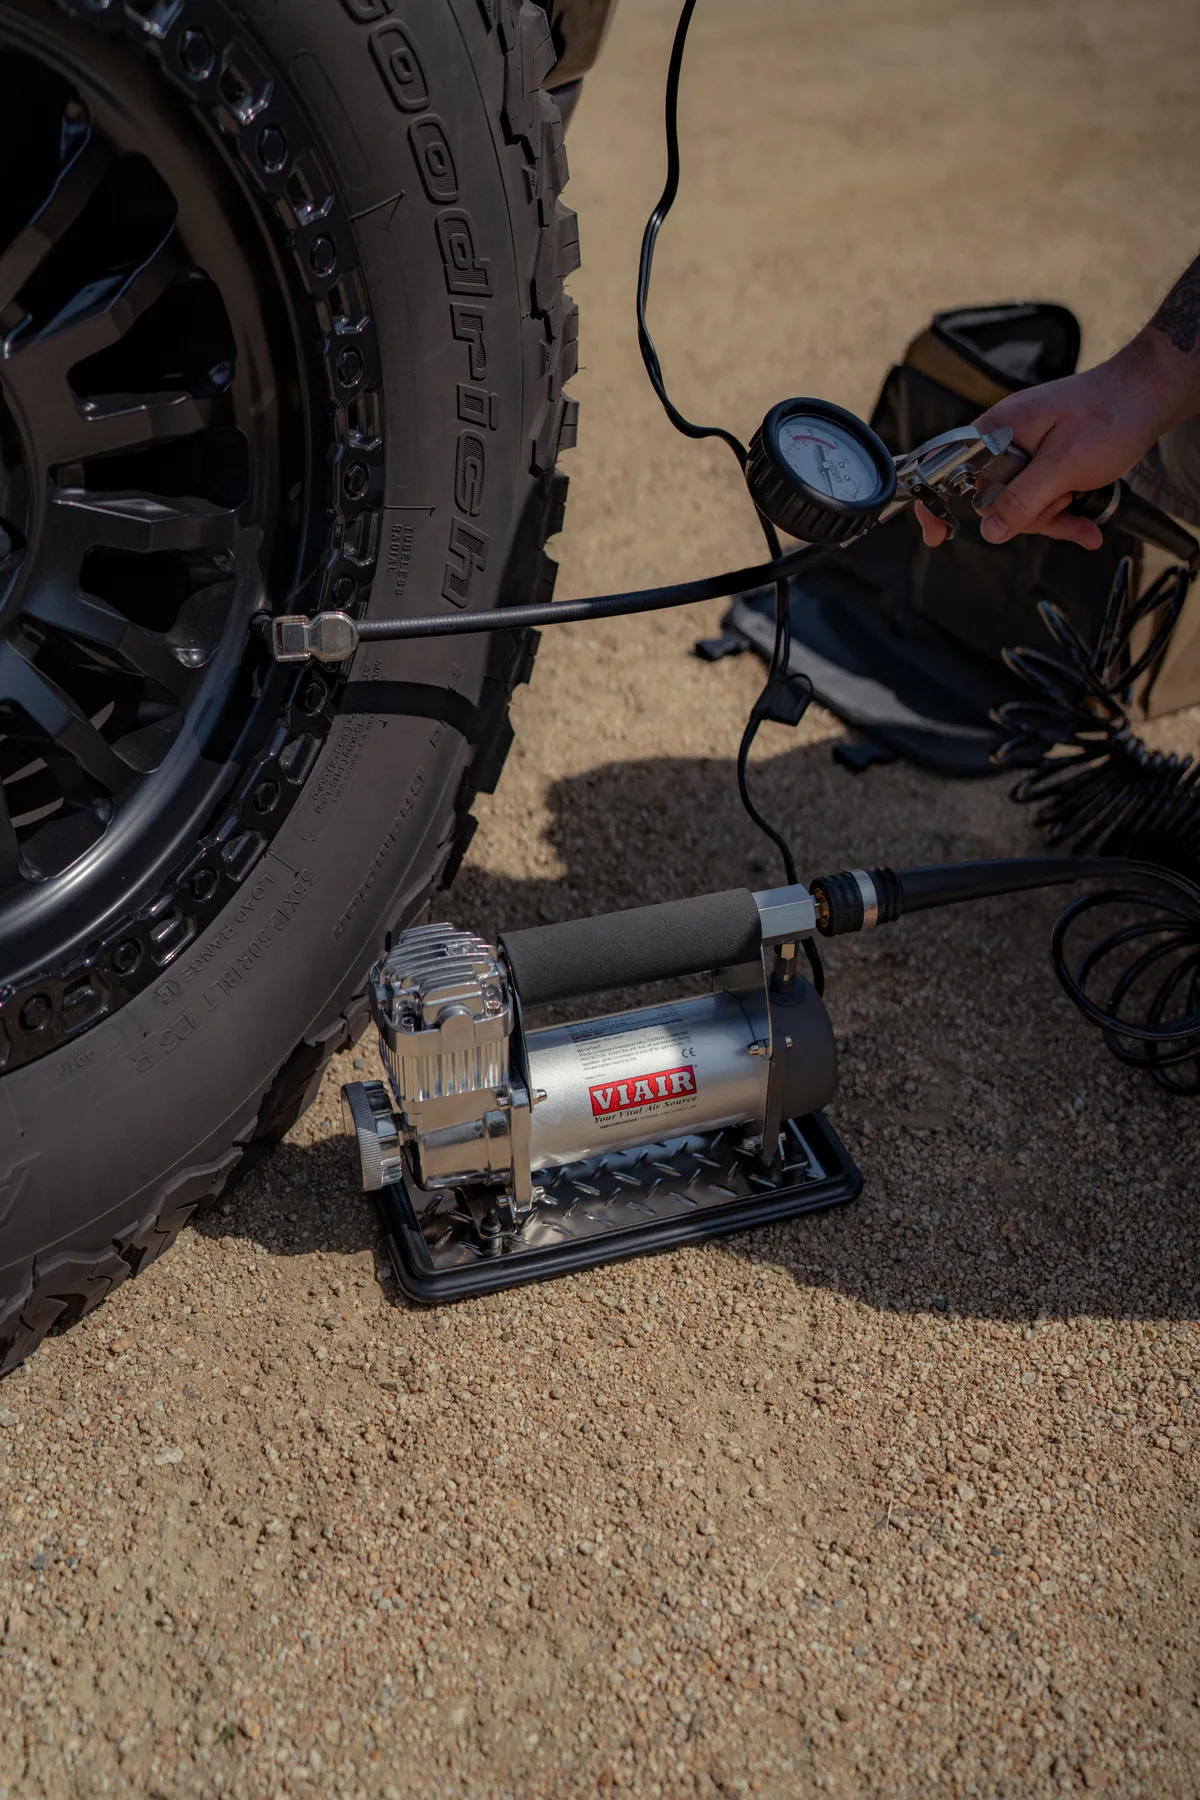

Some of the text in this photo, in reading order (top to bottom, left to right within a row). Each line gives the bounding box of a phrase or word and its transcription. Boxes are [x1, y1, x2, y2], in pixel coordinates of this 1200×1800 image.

[386, 522, 402, 574] RADIAL
[394, 523, 414, 597] TUBELESS
[232, 873, 275, 925] LOAD
[180, 924, 236, 984] RANGE
[681, 1046, 696, 1059] CE
[592, 1071, 694, 1110] VIAIR
[594, 1114, 617, 1124] Your
[619, 1107, 643, 1119] Vital
[643, 1103, 661, 1112] Air
[663, 1096, 698, 1108] Source
